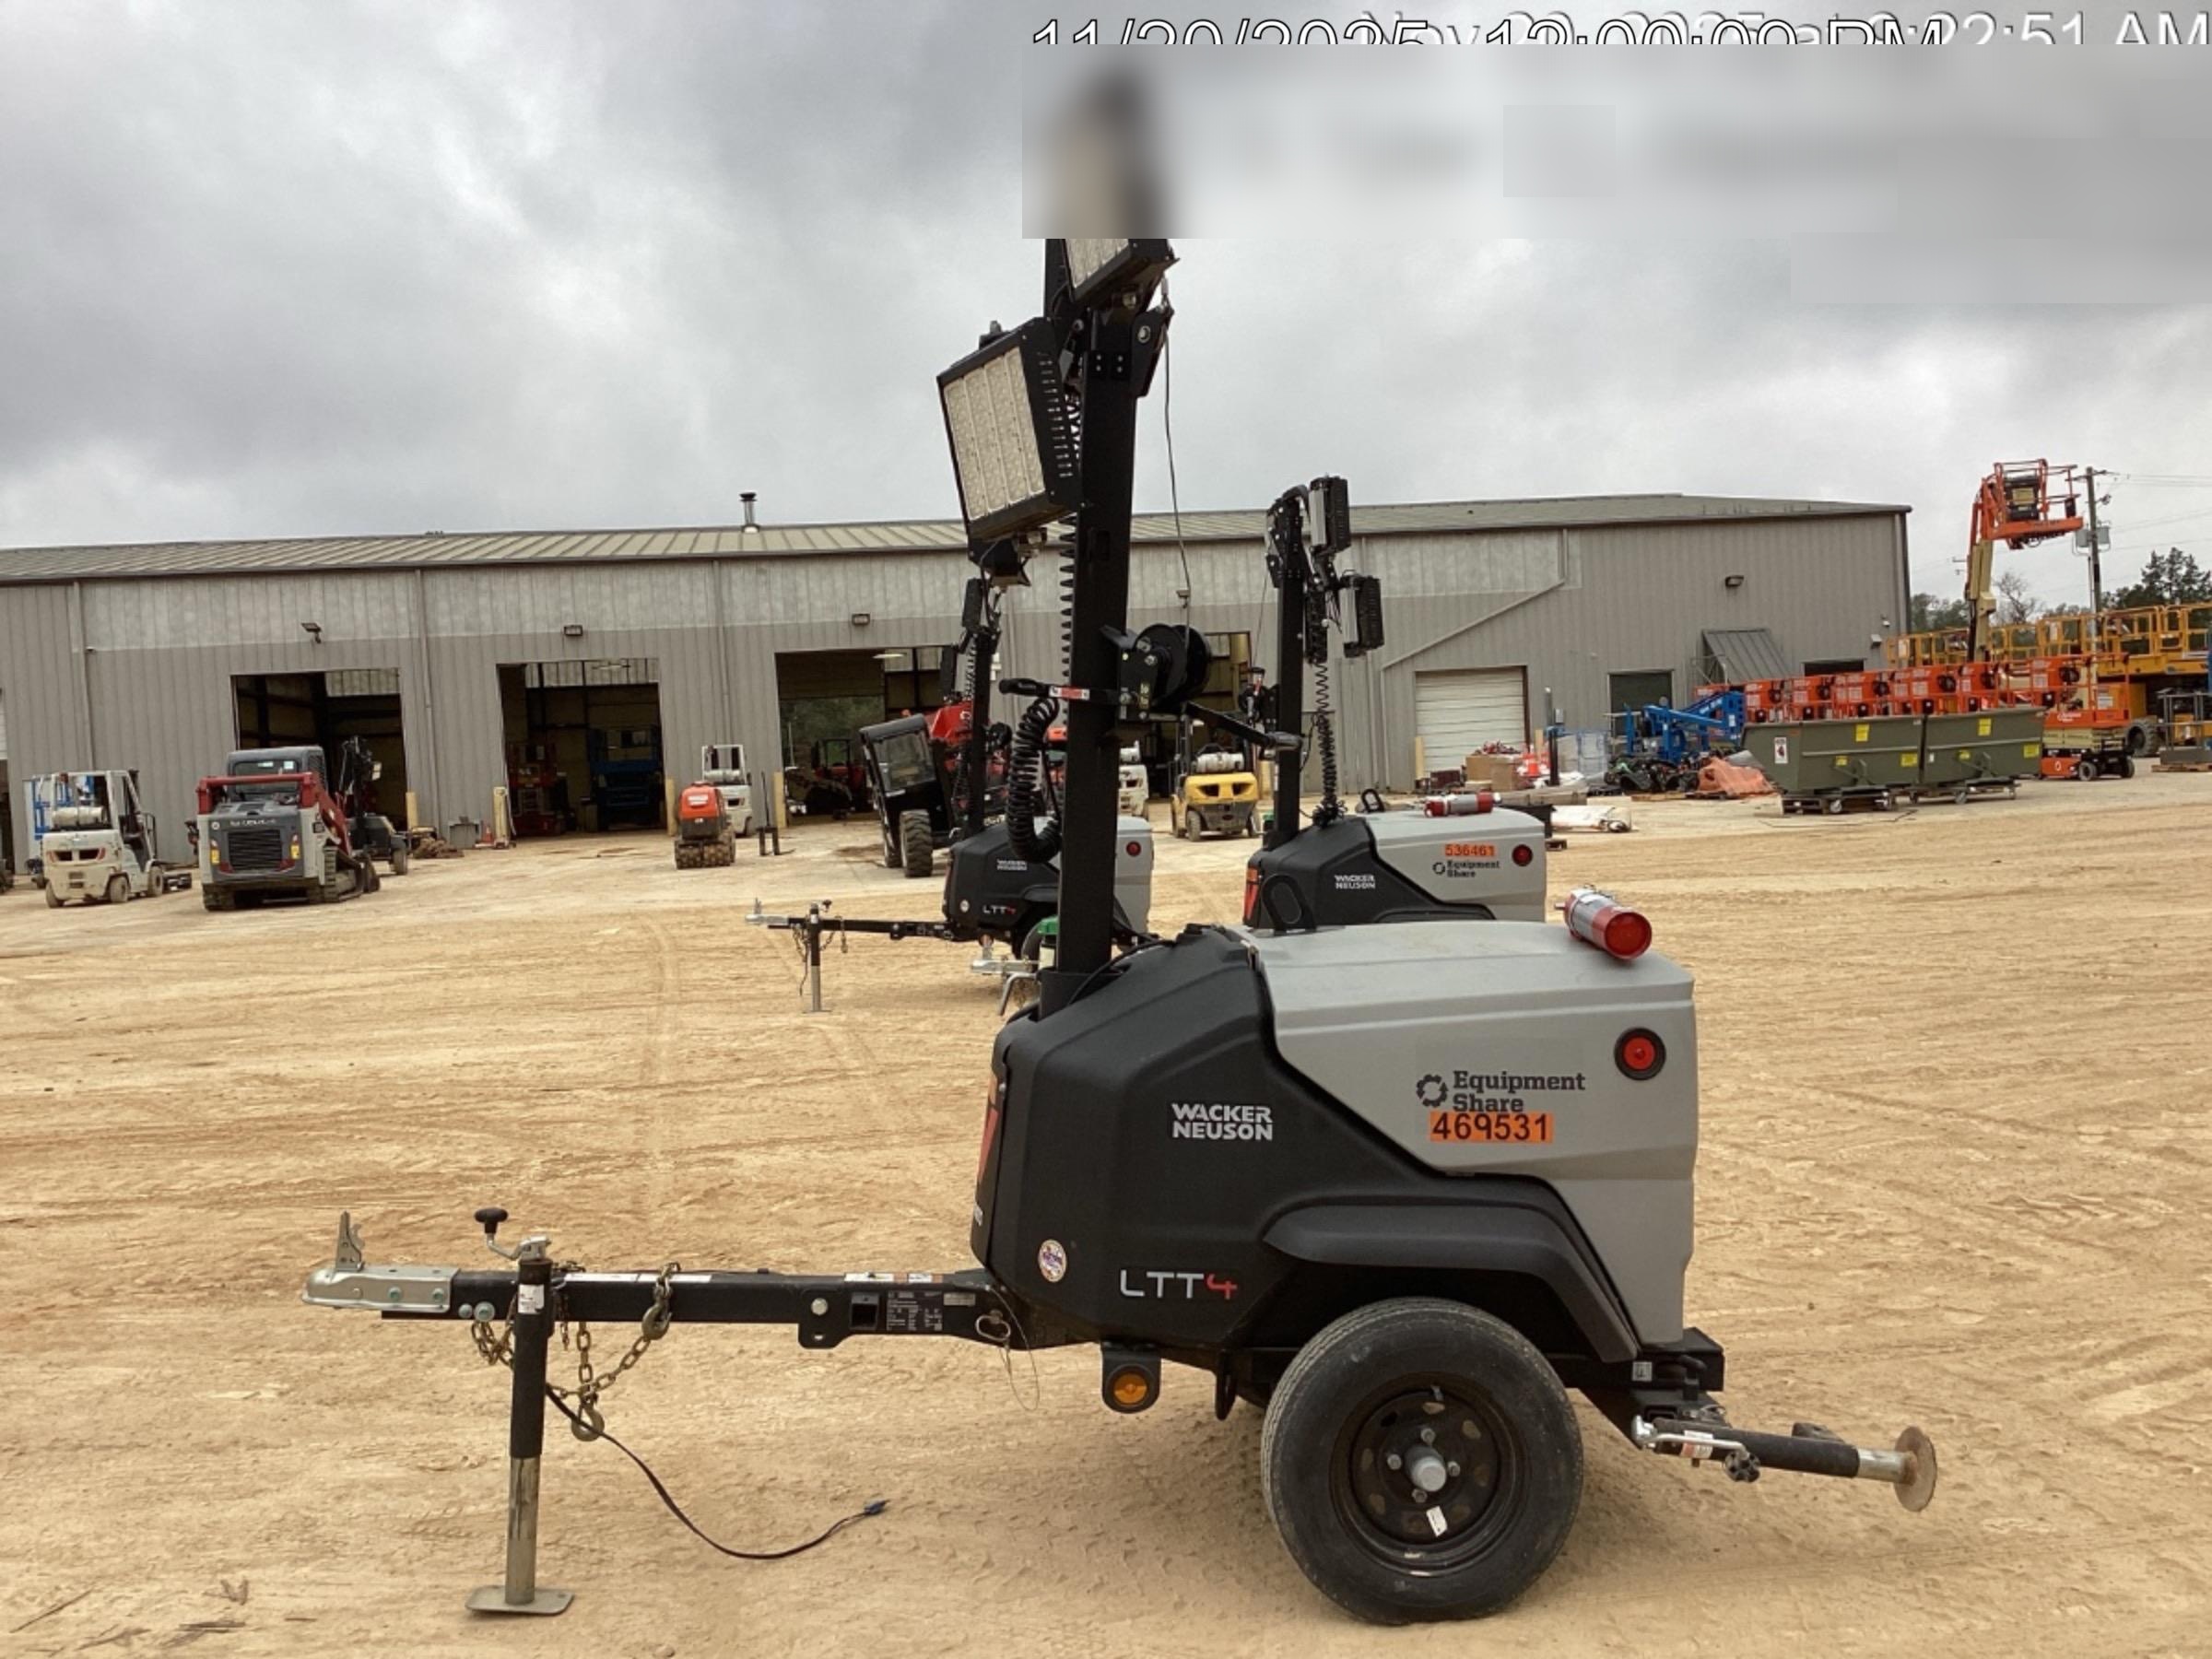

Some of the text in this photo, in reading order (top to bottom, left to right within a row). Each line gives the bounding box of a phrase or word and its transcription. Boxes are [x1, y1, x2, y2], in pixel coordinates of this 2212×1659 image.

[1447, 860, 1500, 870] Equipment
[1453, 1070, 1586, 1094] Equipment
[1453, 1093, 1524, 1112] Share
[1171, 1103, 1273, 1123] WACKER
[1172, 1121, 1273, 1140] NEUSON
[1432, 1112, 1547, 1140] 469531
[1120, 1269, 1238, 1300] LTT4
